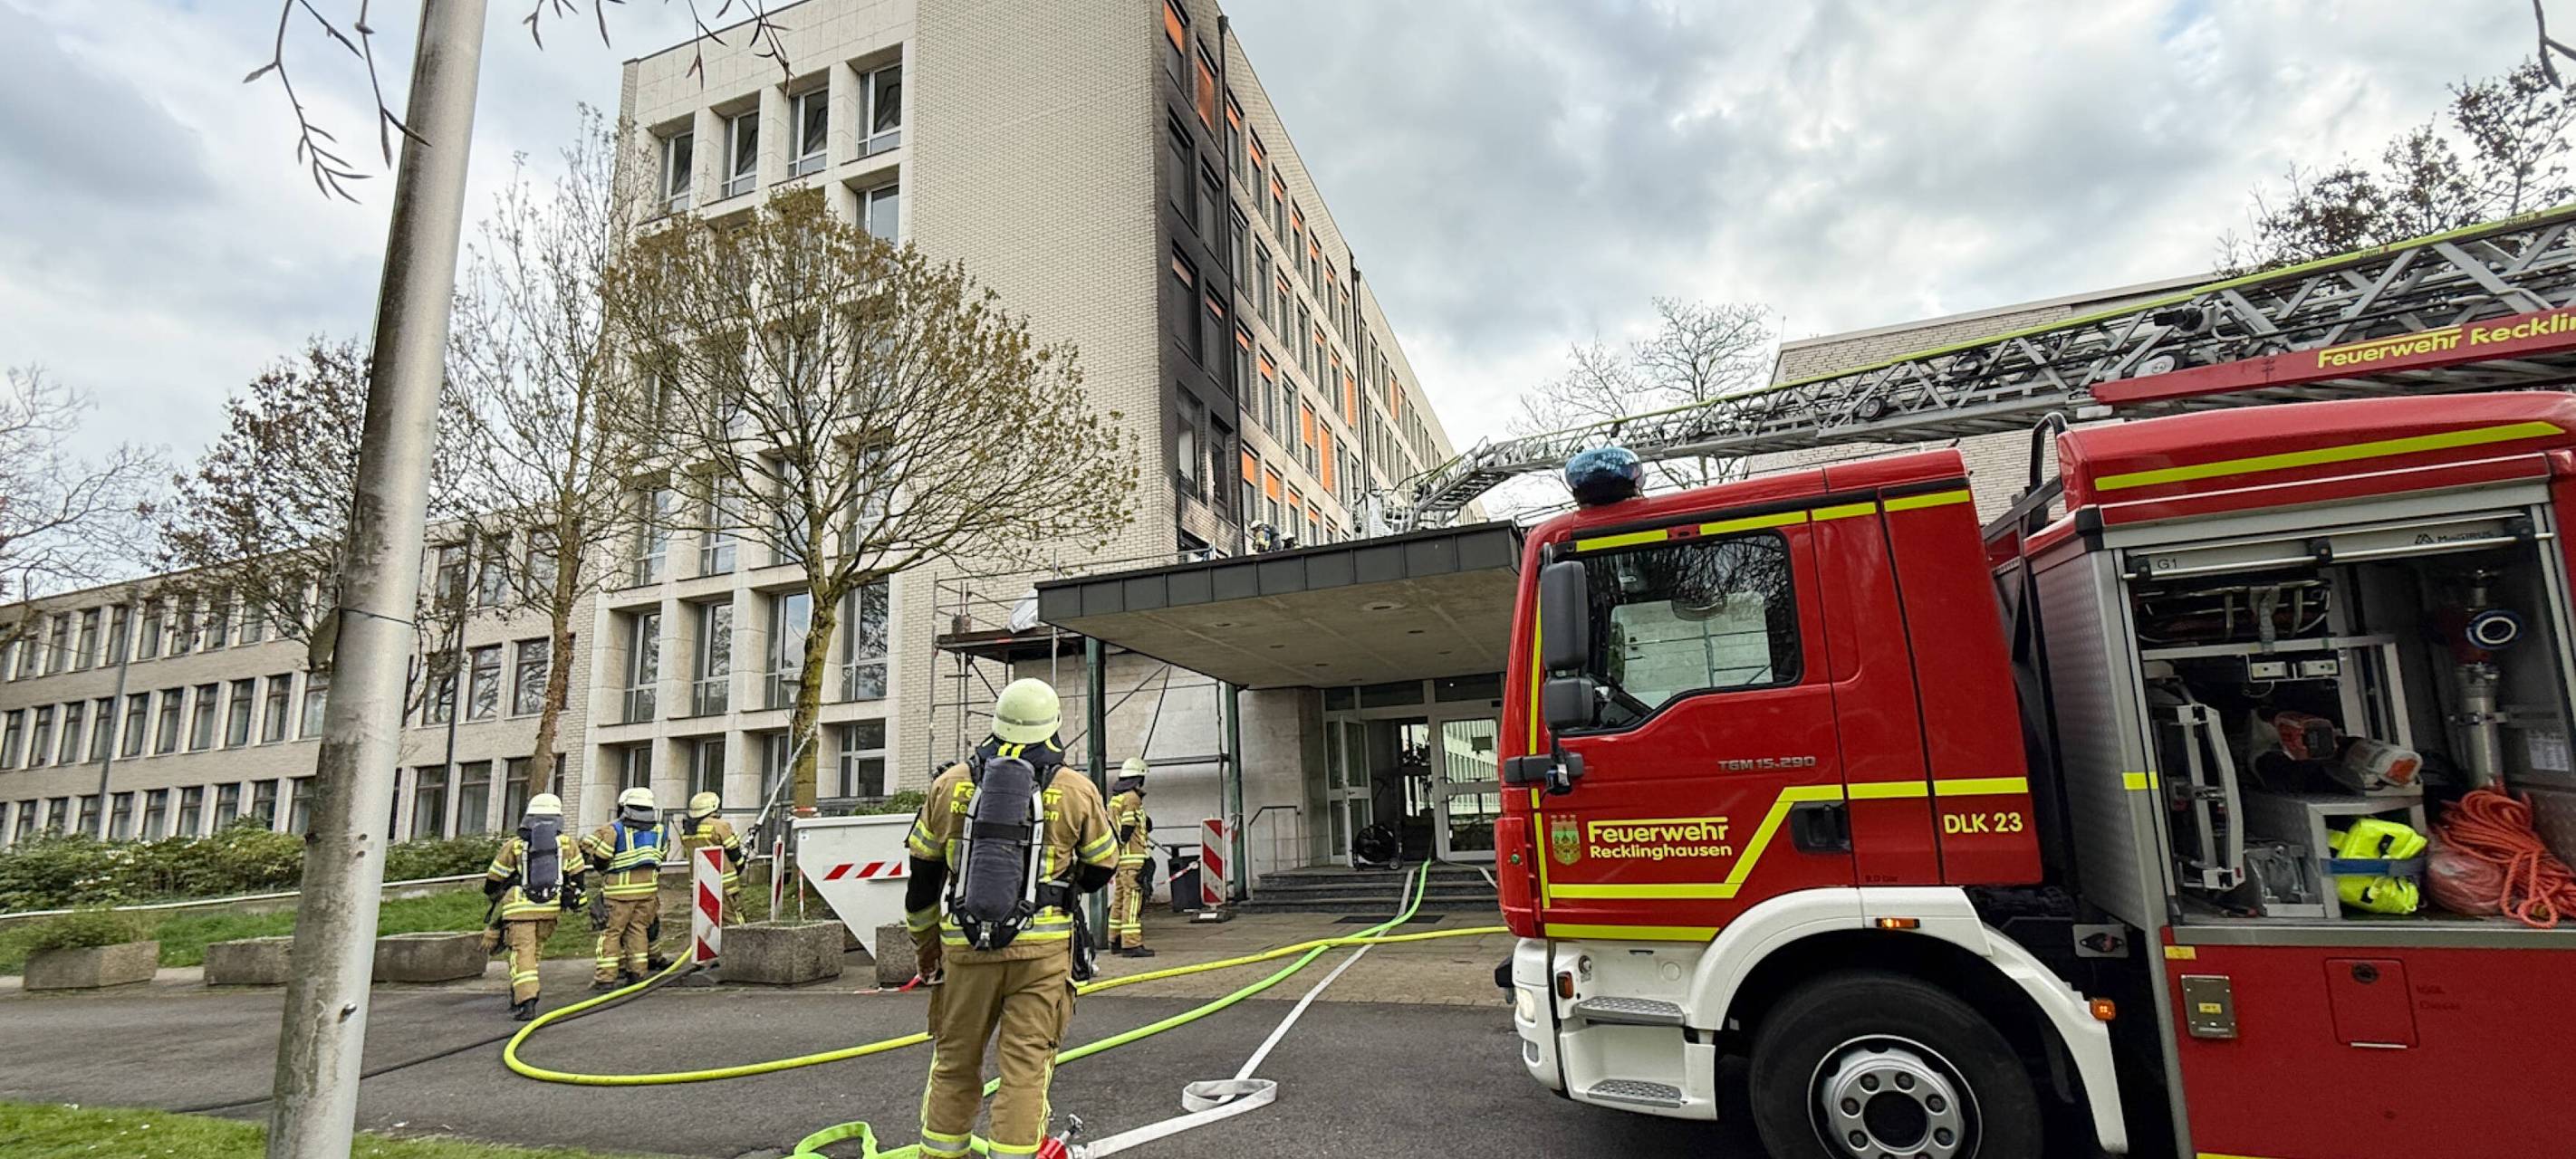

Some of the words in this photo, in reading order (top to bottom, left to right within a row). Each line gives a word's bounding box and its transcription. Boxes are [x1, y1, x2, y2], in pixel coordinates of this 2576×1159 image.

[2317, 327, 2463, 369] Feuerwehr
[2158, 558, 2177, 570] G1
[1717, 759, 1754, 771] TGM
[1755, 756, 1817, 770] 15.290
[1588, 817, 1729, 843] Feuerwehr
[1943, 813, 1990, 834] DLK
[1994, 812, 2023, 833] 23
[1590, 844, 1733, 860] Recklinghausen
